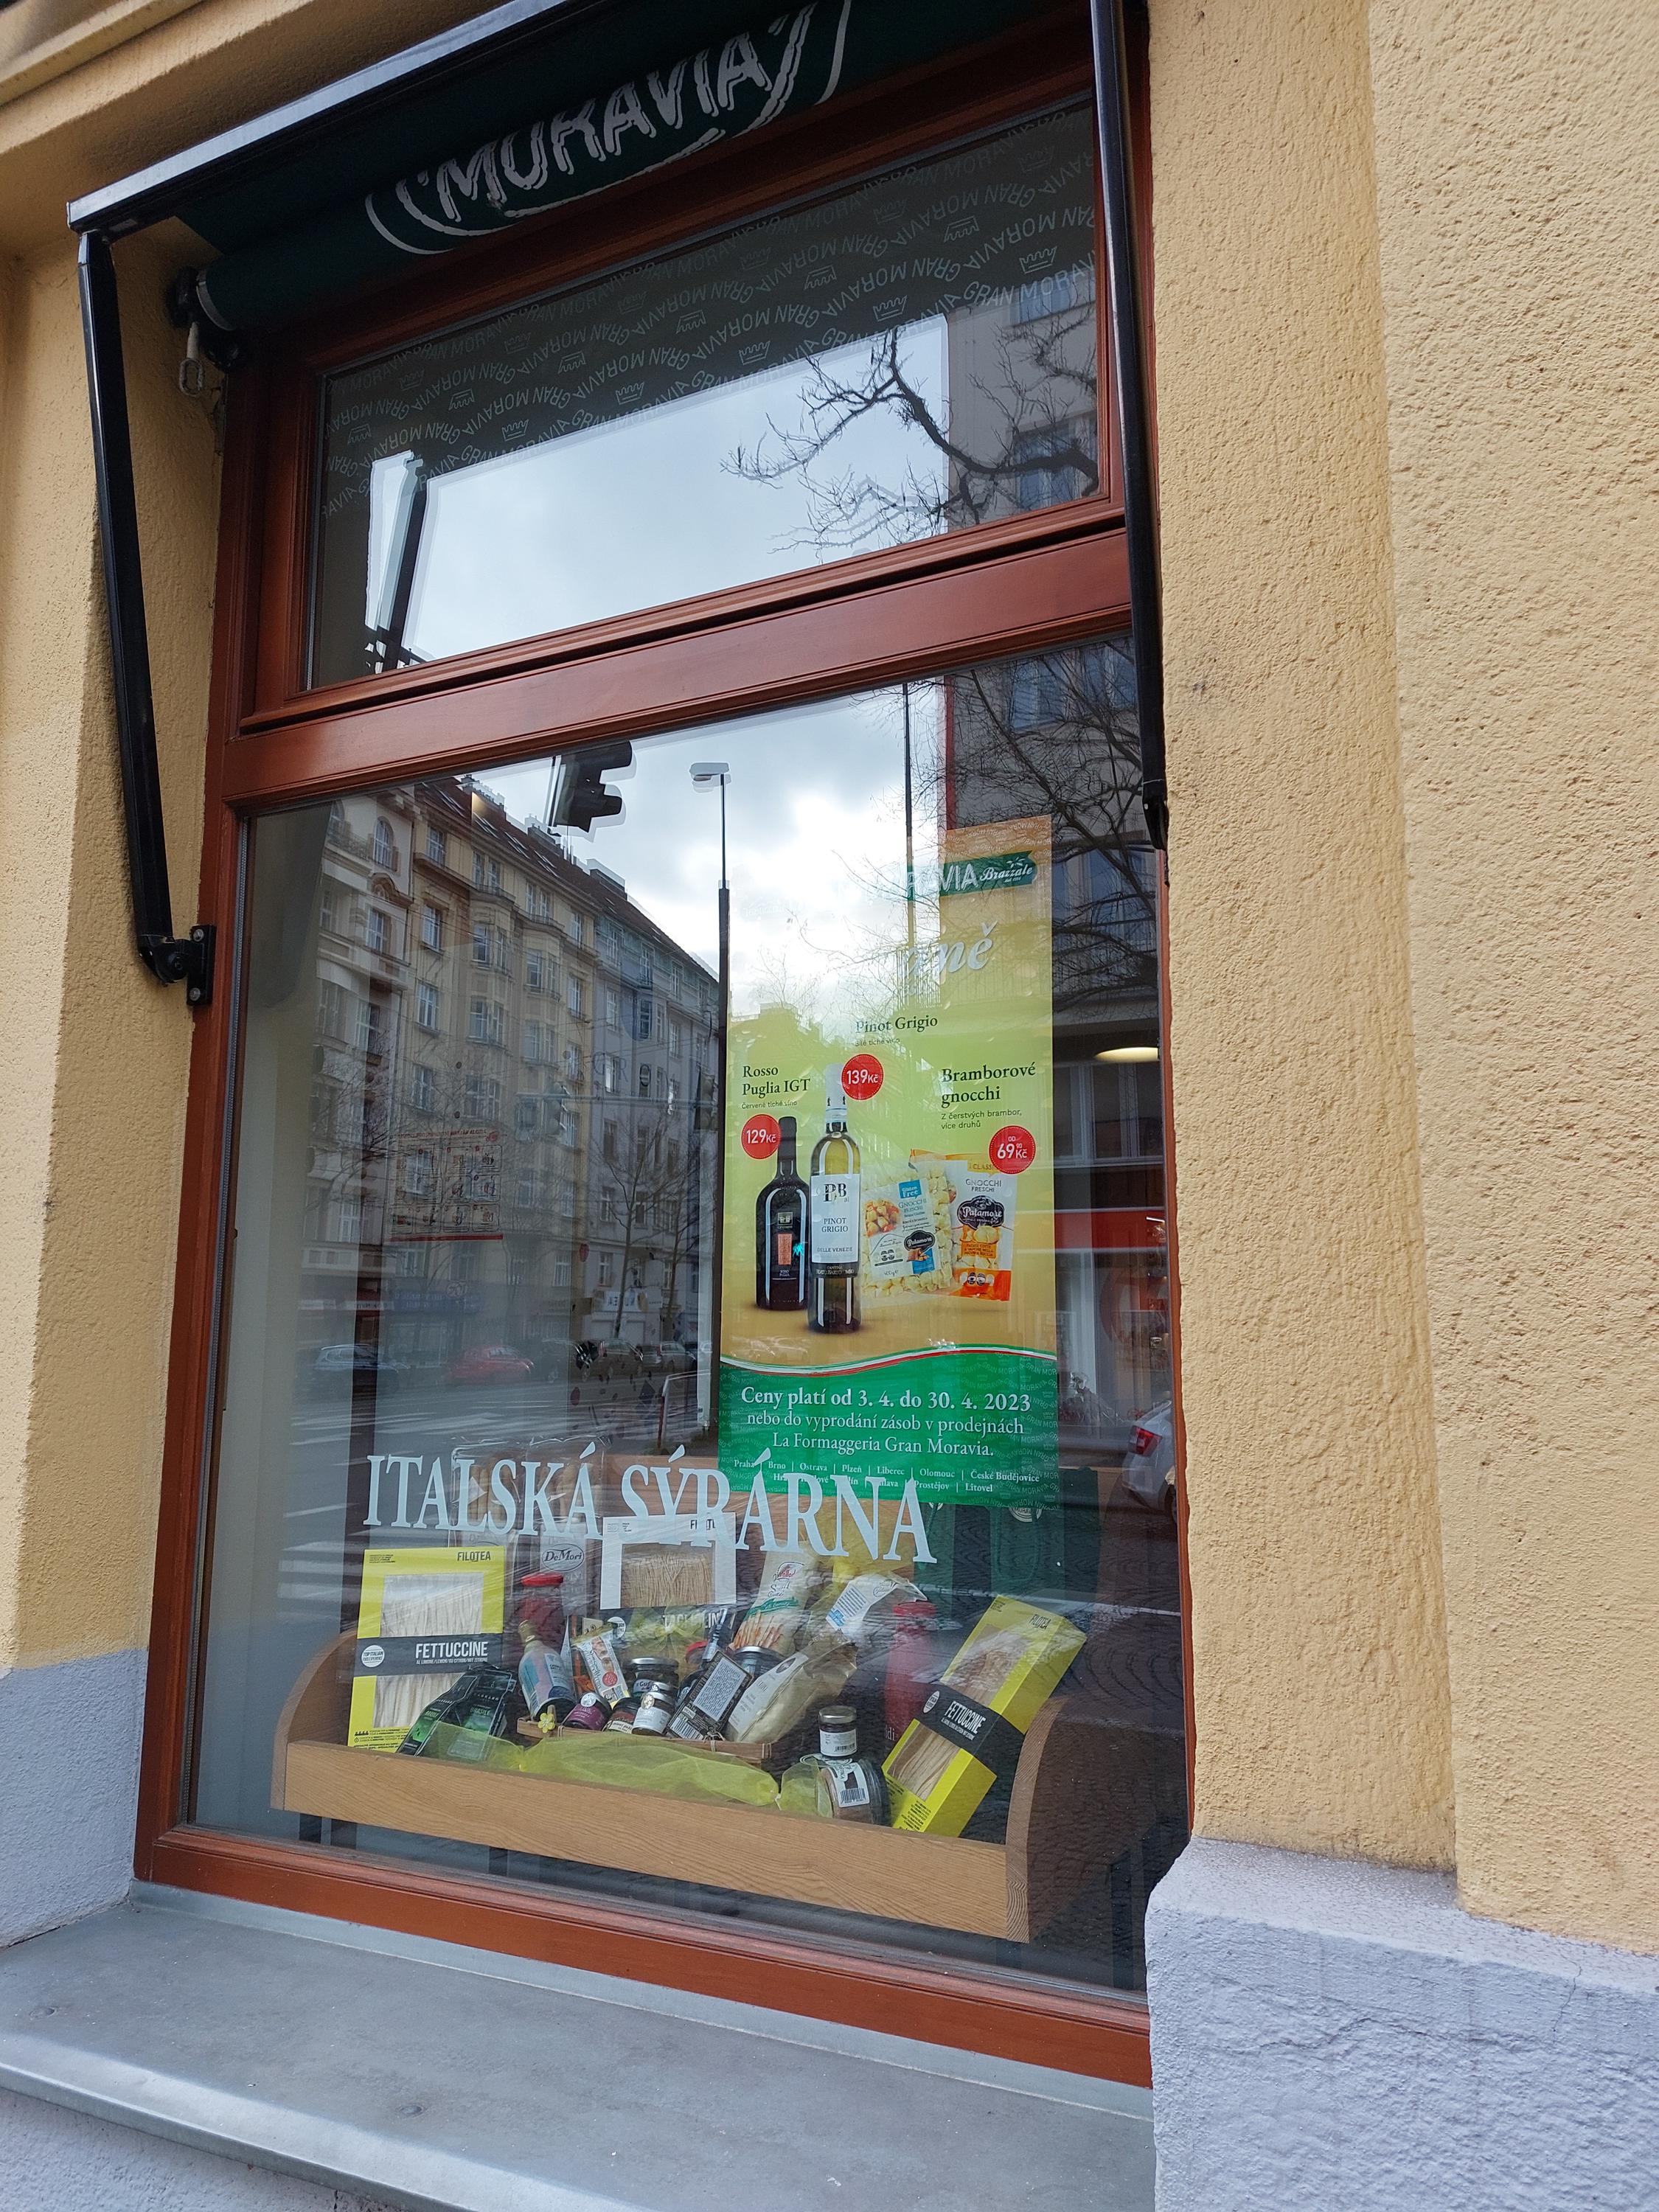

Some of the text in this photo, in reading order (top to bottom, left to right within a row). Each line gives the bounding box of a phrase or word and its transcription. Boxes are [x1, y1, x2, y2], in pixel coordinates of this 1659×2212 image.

[964, 212, 1057, 270] MORAVIA
[912, 257, 961, 282] GRAN
[963, 281, 1015, 306] GRAN
[1020, 251, 1094, 302] MORAV
[821, 262, 907, 317] MORAVIA
[775, 304, 820, 328] GRAN
[692, 308, 770, 361] MORAVIA
[649, 347, 692, 371] GRAN
[572, 349, 644, 400] MORAVIA
[532, 386, 571, 410] GRAN
[462, 392, 529, 435] MORAVIA
[425, 422, 461, 445] GRAN
[360, 425, 422, 469] MORAVIA
[327, 456, 358, 478] GRAN
[979, 864, 1033, 882] Brazzale
[855, 1015, 939, 1034] Pinot Grigio
[742, 1065, 779, 1077] Rosso
[942, 1062, 1036, 1082] Bramborové
[742, 1079, 811, 1099] Puglia IGT
[941, 1086, 1001, 1109] gnocchi
[941, 1120, 981, 1130] více druhů
[948, 1110, 984, 1120] čerstvých
[987, 1109, 1022, 1118] brambor,
[997, 1144, 1015, 1159] 69
[1016, 1149, 1027, 1158] Kč
[966, 1179, 1002, 1187] GNOCCHI
[742, 1387, 1032, 1411] Ceny platí od 3. 4. do 30. 4. 2023
[747, 1410, 780, 1426] nebo
[784, 1411, 801, 1426] do
[805, 1412, 877, 1433] vyprodání
[881, 1415, 922, 1430] zásob
[925, 1420, 934, 1430] v
[938, 1416, 1024, 1439] prodejnách
[773, 1432, 790, 1447] La
[793, 1433, 881, 1455] Formaggeria
[886, 1436, 922, 1453] Gran
[928, 1438, 994, 1457] Moravia.
[734, 1460, 755, 1469] Praha
[768, 1461, 786, 1470] Brno
[799, 1462, 827, 1472] Ostrava
[842, 1464, 862, 1474] Plzeň
[877, 1466, 905, 1475] Liberec
[919, 1467, 956, 1478] Olomouc
[970, 1469, 994, 1480] České
[995, 1470, 1040, 1484] Budějovice
[914, 1481, 950, 1492] Prostějov
[965, 1482, 993, 1493] Litovel
[363, 1442, 938, 1565] ITALSKÁ SÝRÁRNA
[457, 1551, 491, 1562] FILOTEA
[1029, 1613, 1052, 1630] FILOTEA
[415, 1641, 488, 1659] FETTUCCINE
[945, 1700, 987, 1734] FETTUCCINE
